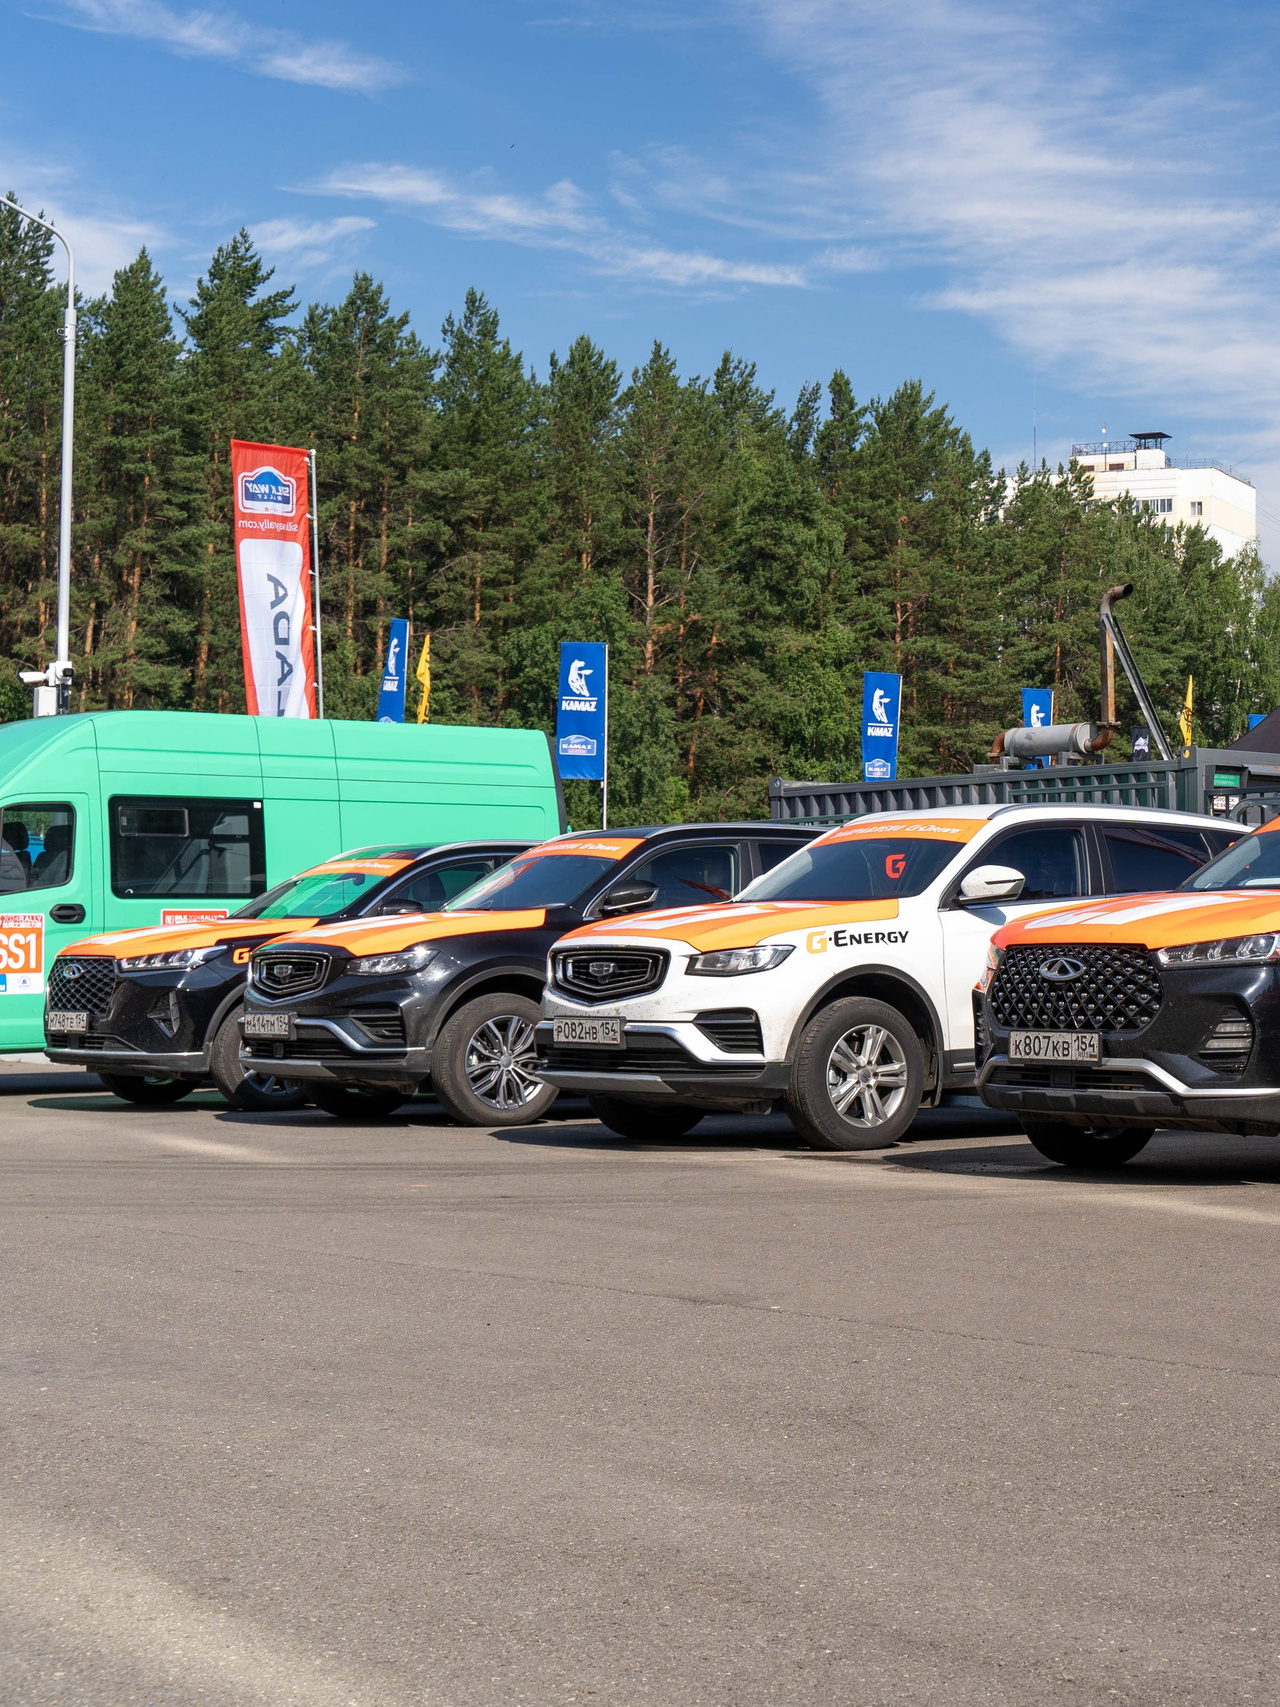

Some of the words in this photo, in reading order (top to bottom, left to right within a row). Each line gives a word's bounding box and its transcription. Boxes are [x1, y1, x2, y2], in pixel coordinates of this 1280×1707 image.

[562, 700, 598, 712] KAMAZ
[75, 1013, 85, 1025] 154
[556, 1022, 598, 1040] Р082НВ
[600, 1022, 617, 1036] 154
[1014, 1035, 1070, 1057] К807КВ
[1074, 1036, 1096, 1053] 154
